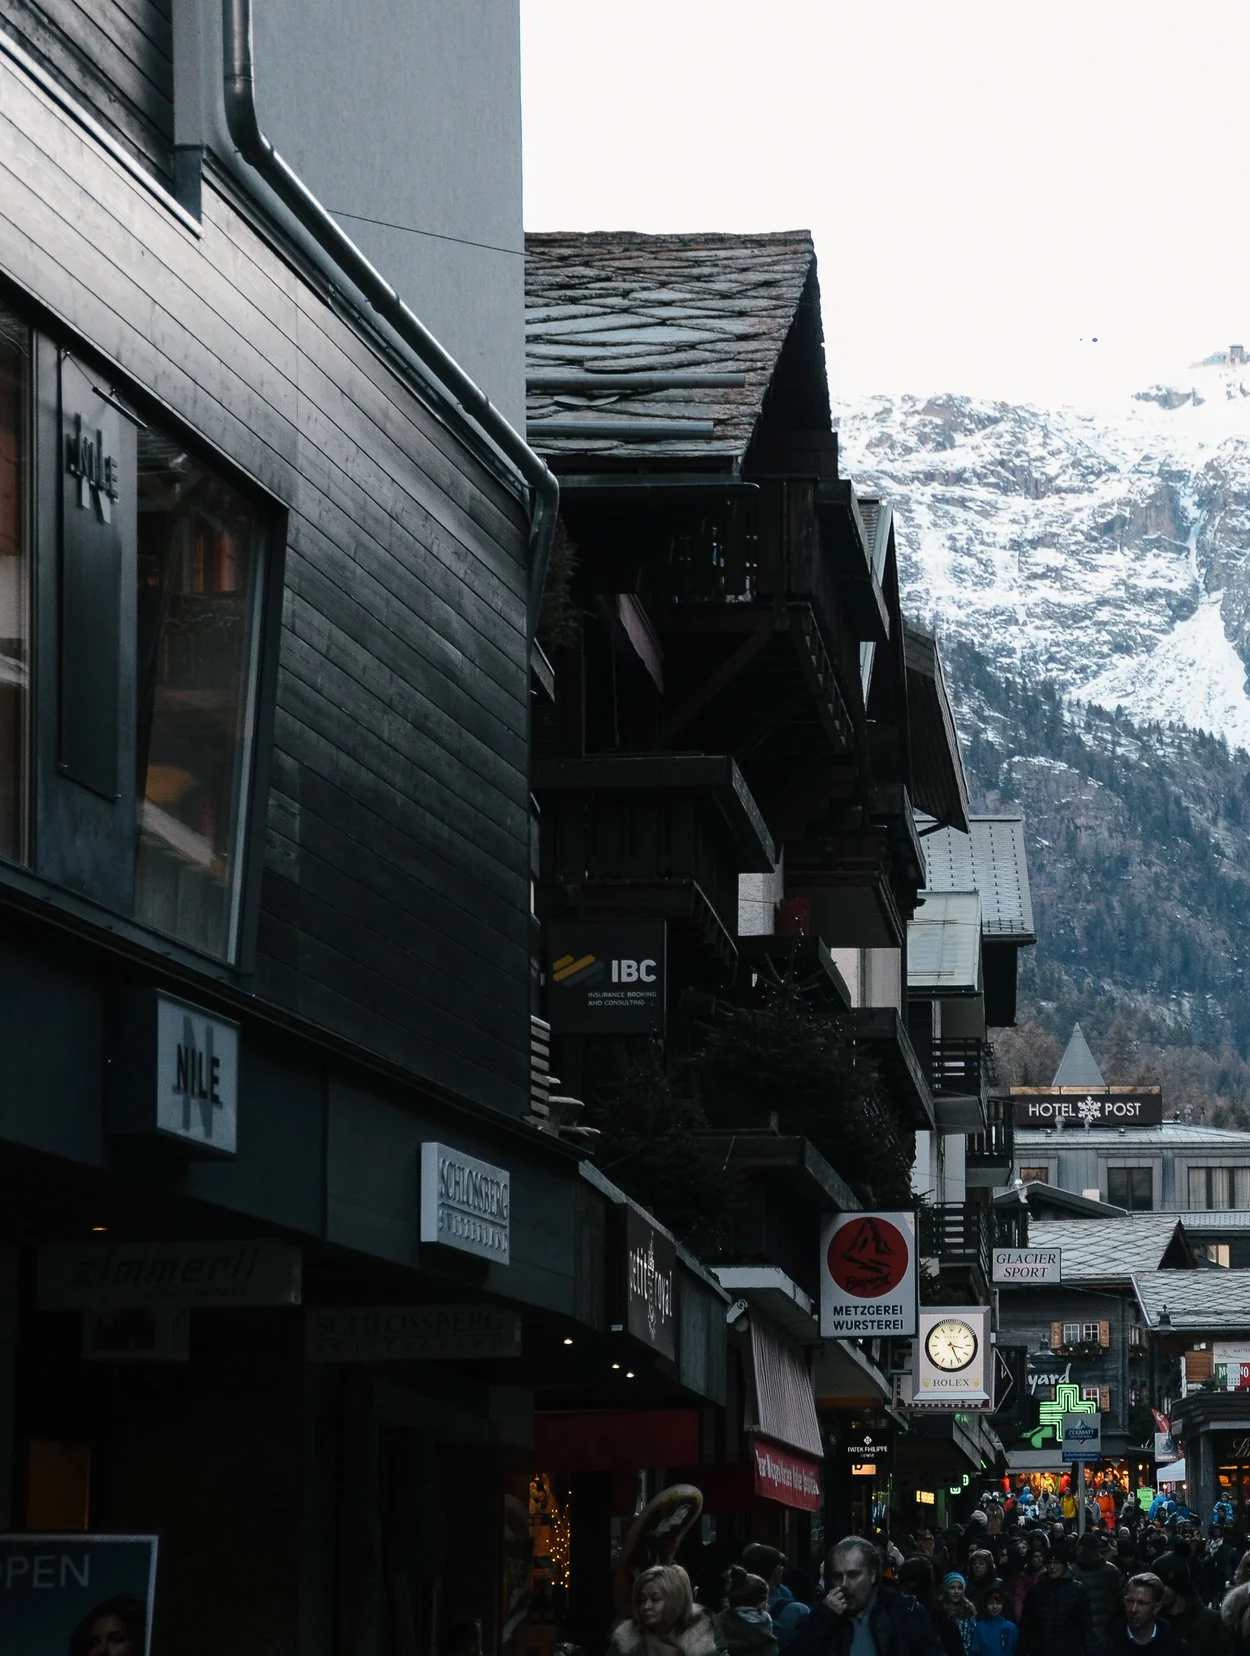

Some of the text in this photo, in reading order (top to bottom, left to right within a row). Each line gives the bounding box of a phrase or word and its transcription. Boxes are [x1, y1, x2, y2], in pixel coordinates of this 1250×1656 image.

[611, 959, 657, 983] IBC
[177, 1043, 220, 1104] NILE
[1028, 1102, 1141, 1117] HOTEL POST
[441, 1157, 508, 1220] SCHLOSSBERG
[71, 1245, 260, 1286] zimmerli
[996, 1253, 1056, 1264] GLACIER
[1003, 1266, 1049, 1278] SPORT
[833, 1304, 903, 1316] METZGEREI
[317, 1310, 504, 1336] SCHLOSSBERG
[833, 1319, 904, 1331] WURSTEREI
[933, 1379, 970, 1387] ROLEX
[0, 1554, 91, 1590] PEN
